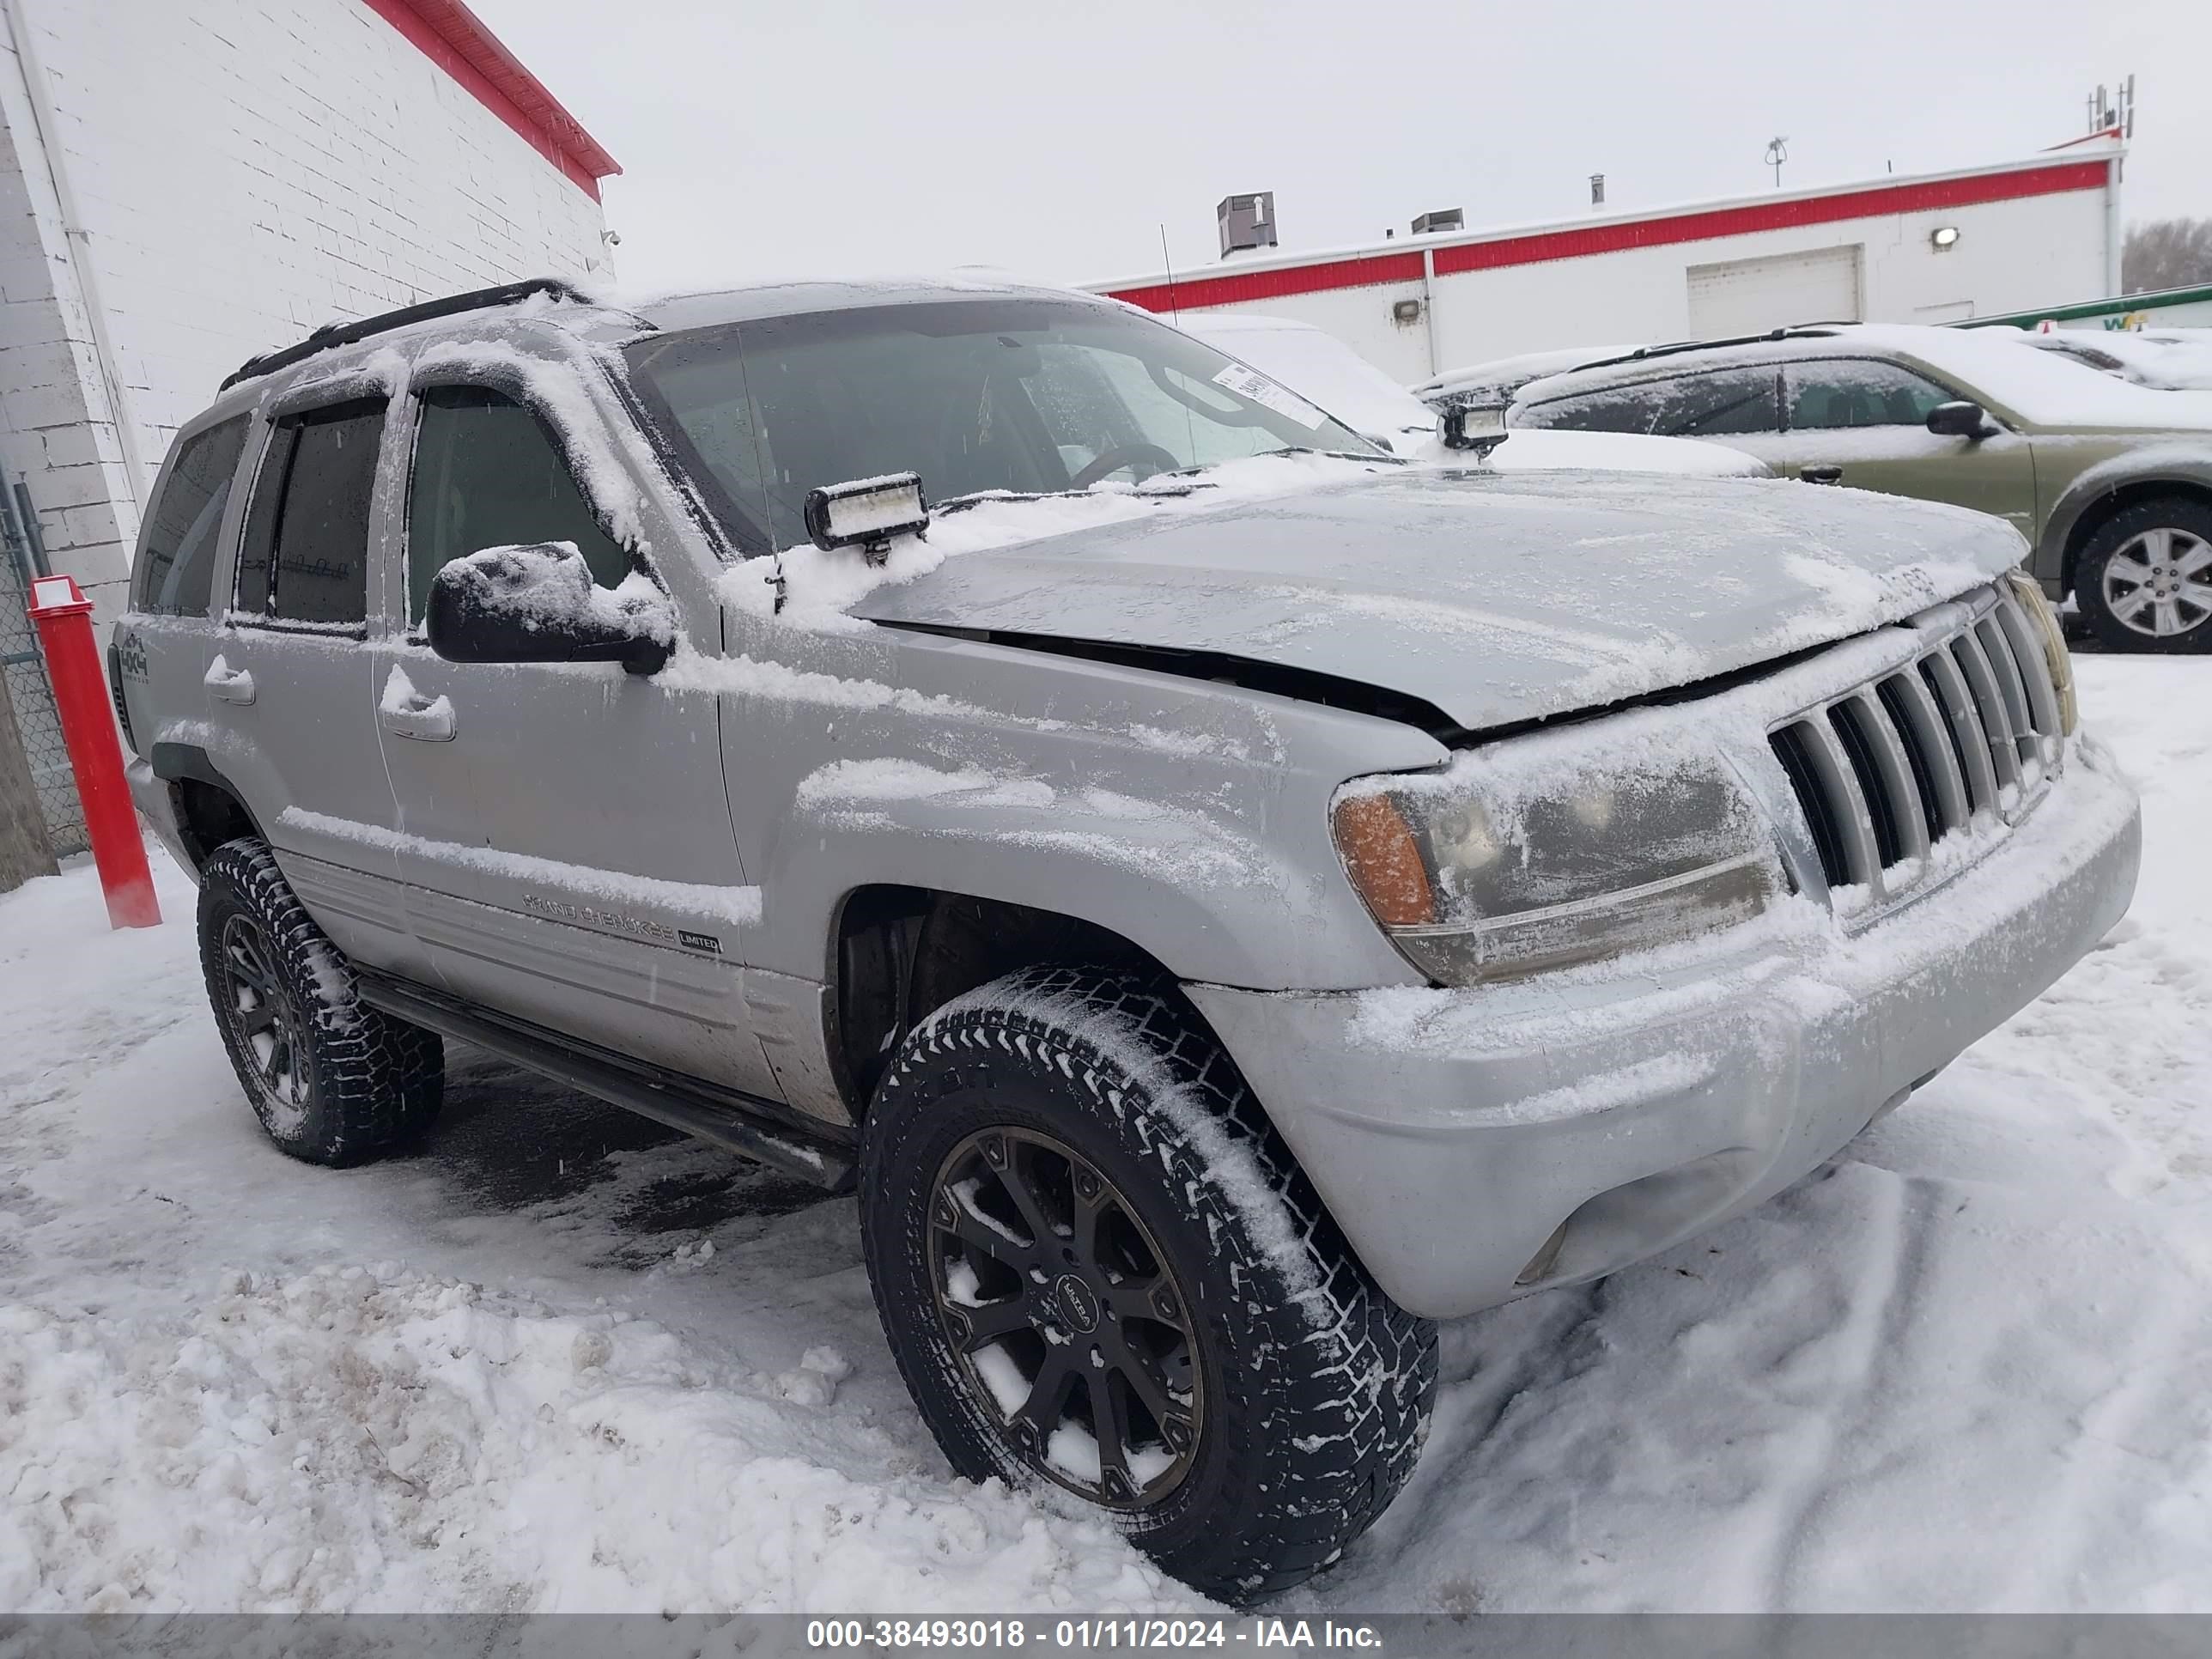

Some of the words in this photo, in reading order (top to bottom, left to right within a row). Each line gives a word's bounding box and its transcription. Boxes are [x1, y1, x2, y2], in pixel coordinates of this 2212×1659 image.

[522, 895, 576, 919] GRAND
[580, 907, 675, 942] CHEROKEE
[679, 933, 718, 949] LIMITED
[1063, 1282, 1091, 1327] ULTRA
